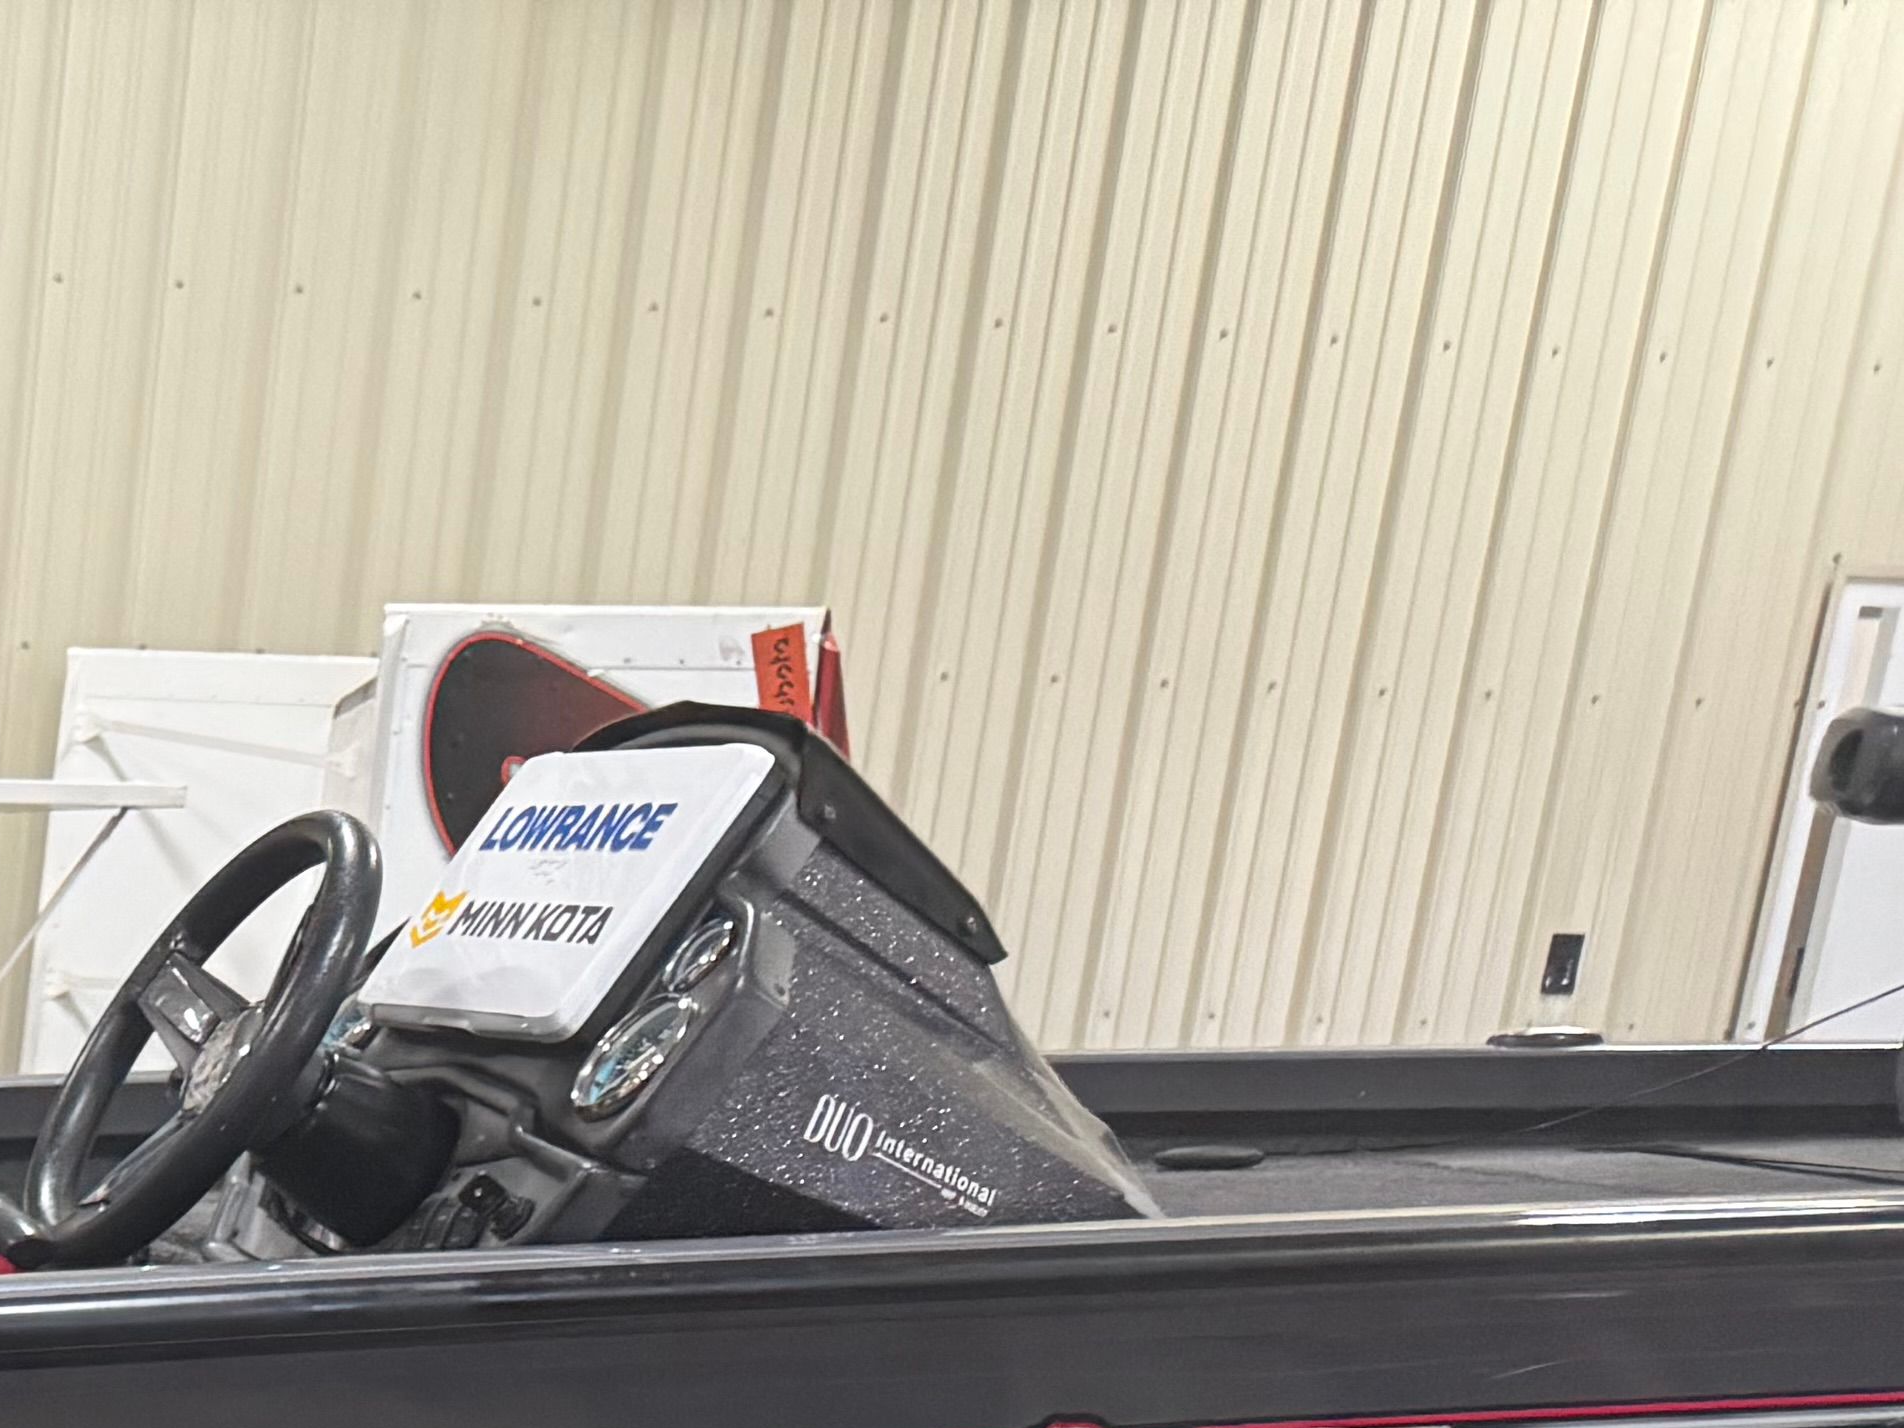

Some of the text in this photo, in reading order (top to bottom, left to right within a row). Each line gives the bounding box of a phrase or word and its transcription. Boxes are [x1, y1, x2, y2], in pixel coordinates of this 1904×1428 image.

[478, 802, 679, 852] LOWRANCE
[446, 899, 615, 945] MINN KOTA
[803, 1093, 875, 1162] DUO
[874, 1129, 998, 1208] International
